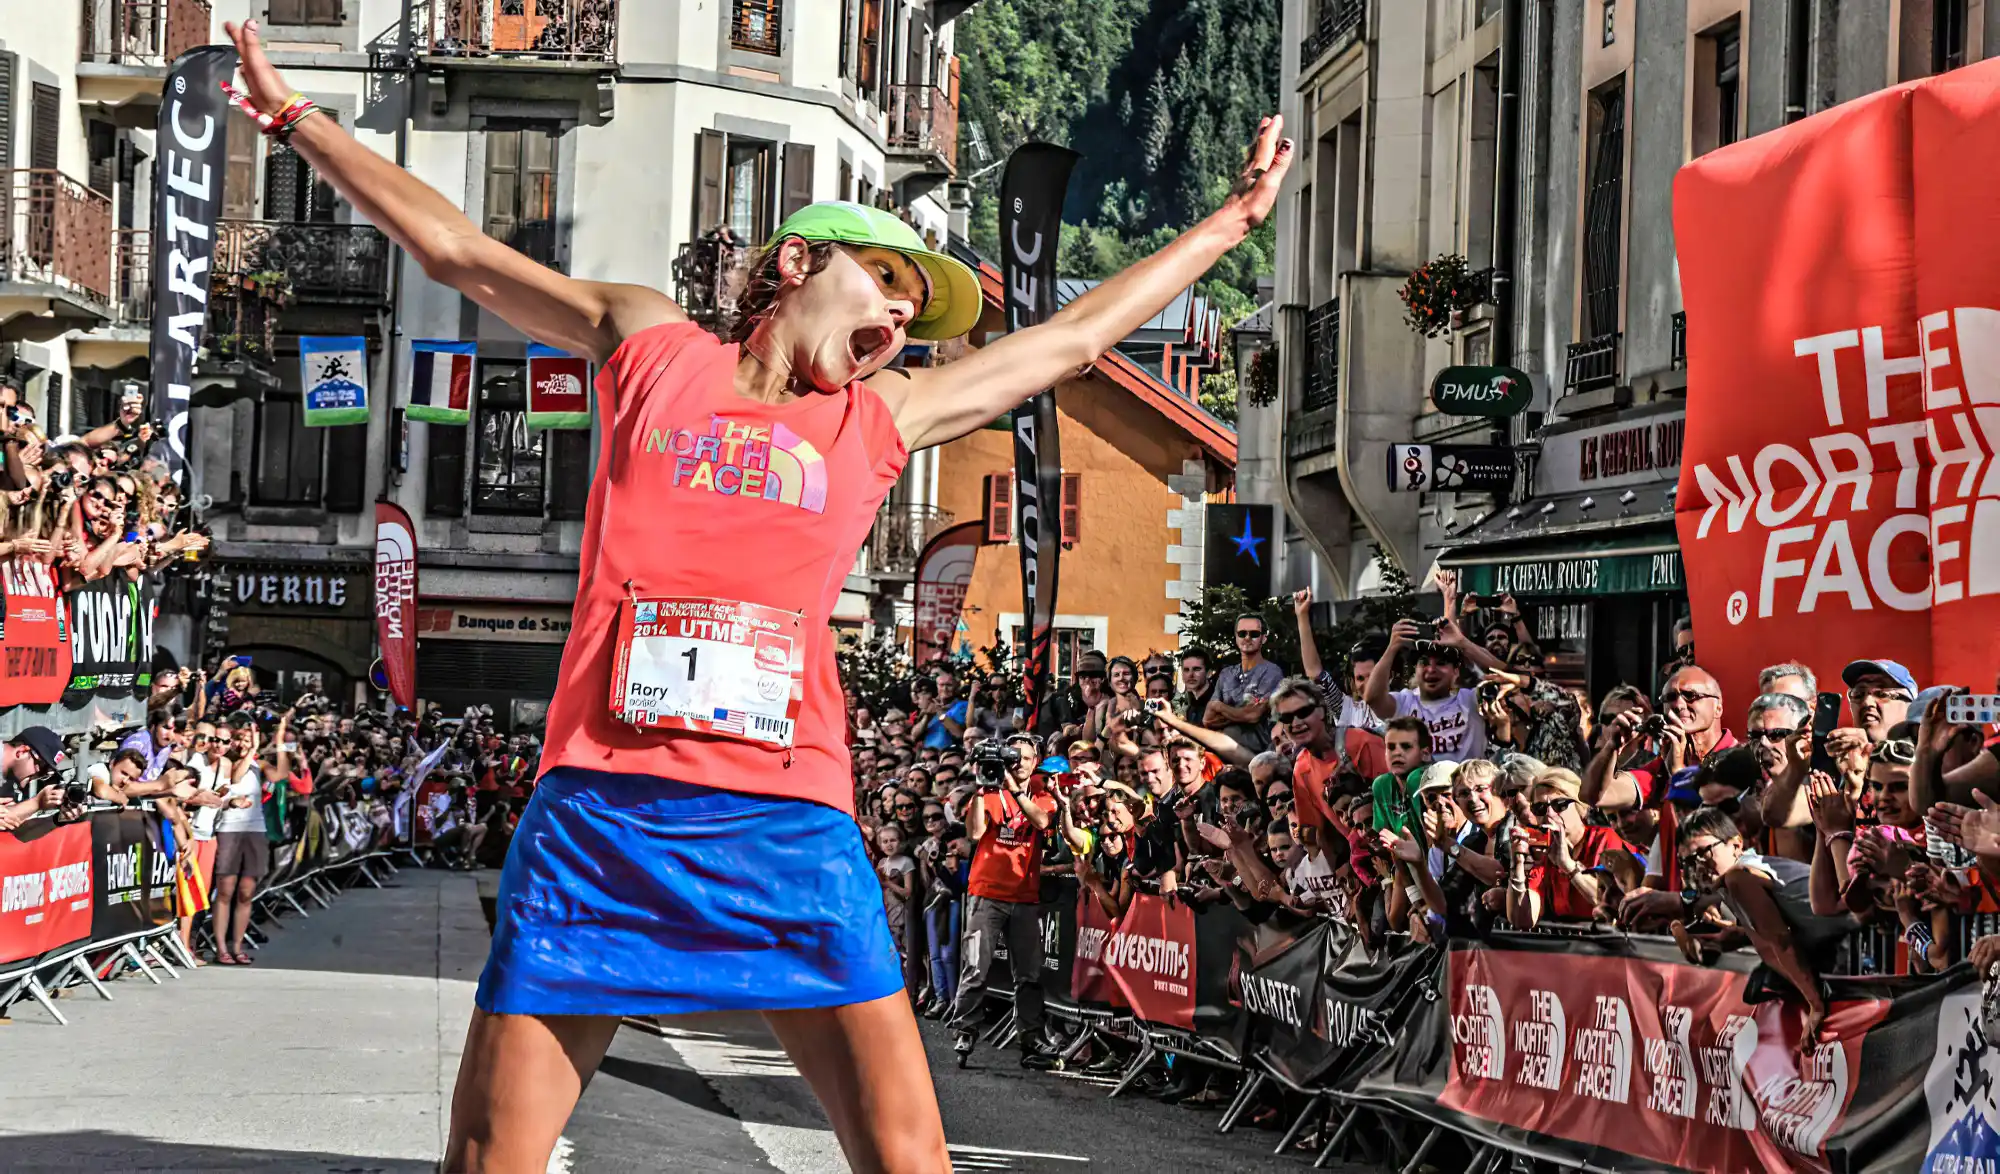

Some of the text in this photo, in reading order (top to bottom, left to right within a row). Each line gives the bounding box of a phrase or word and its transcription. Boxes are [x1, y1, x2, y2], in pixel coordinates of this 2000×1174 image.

[1794, 310, 1962, 427] THE
[1441, 382, 1489, 401] PMU
[646, 428, 768, 470] NORTH
[1579, 435, 1598, 482] LE
[672, 457, 766, 498] FACE
[1693, 412, 1985, 539] NORTH
[1496, 553, 1678, 592] LE CHEVAL ROUGE PMU
[1758, 503, 1968, 619] FACE
[458, 615, 572, 632] Banque de Sav
[633, 618, 746, 643] 2014 UTMB
[681, 647, 698, 682] 1
[631, 682, 669, 701] Rory
[1466, 985, 1488, 1016] THE
[1530, 989, 1551, 1023] THE
[1596, 996, 1617, 1031] THE
[1515, 1020, 1551, 1056] NORTH
[1665, 1005, 1685, 1041] THE
[1574, 1028, 1616, 1066] NORTH
[1812, 1041, 1834, 1080] THE
[1521, 1053, 1548, 1089] FACE
[1579, 1063, 1612, 1100] FACE
[1652, 1075, 1684, 1115] FACE
